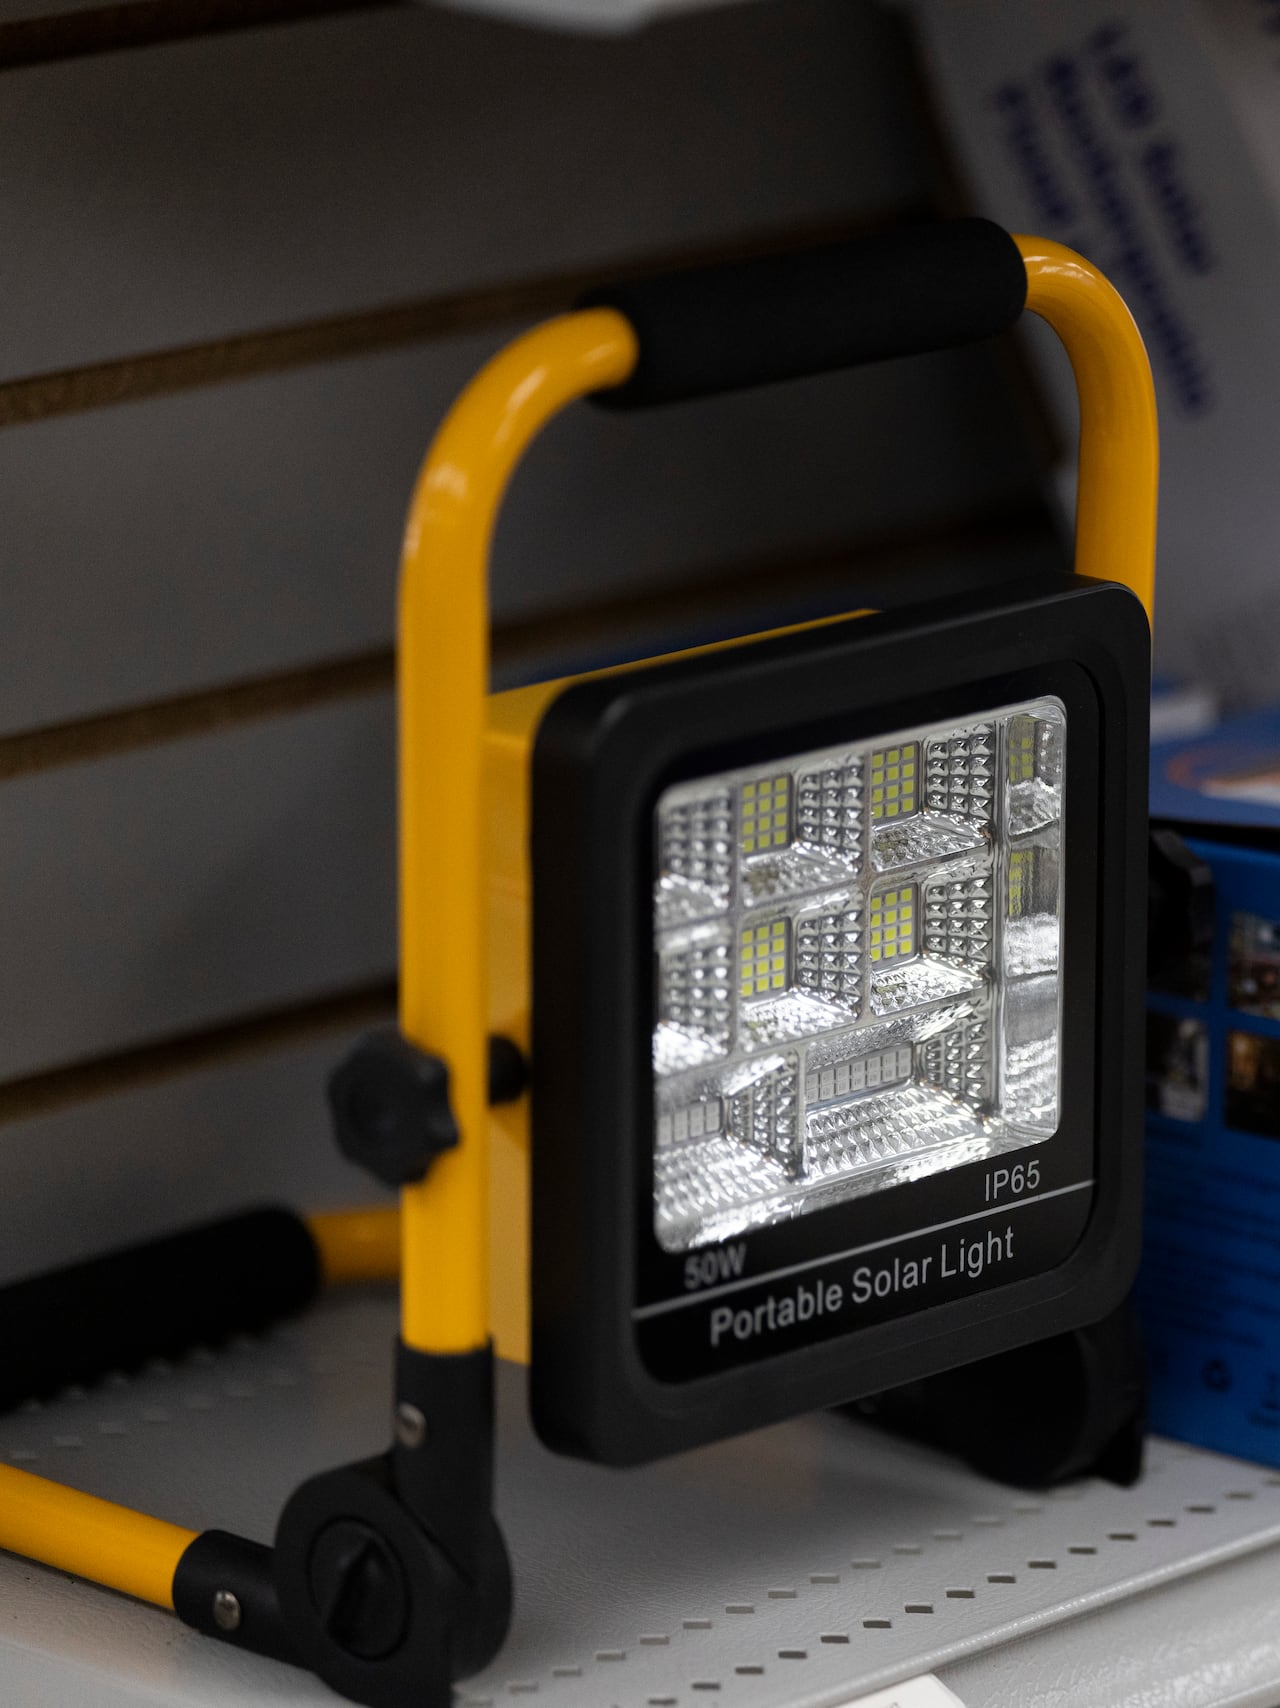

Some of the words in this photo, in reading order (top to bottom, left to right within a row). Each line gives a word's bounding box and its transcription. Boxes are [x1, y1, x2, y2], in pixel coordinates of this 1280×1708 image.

[984, 1160, 1041, 1202] IP65
[683, 1243, 749, 1290] 50W
[709, 1279, 844, 1348] Portable
[852, 1254, 933, 1304] Solar
[940, 1226, 1015, 1279] Light
